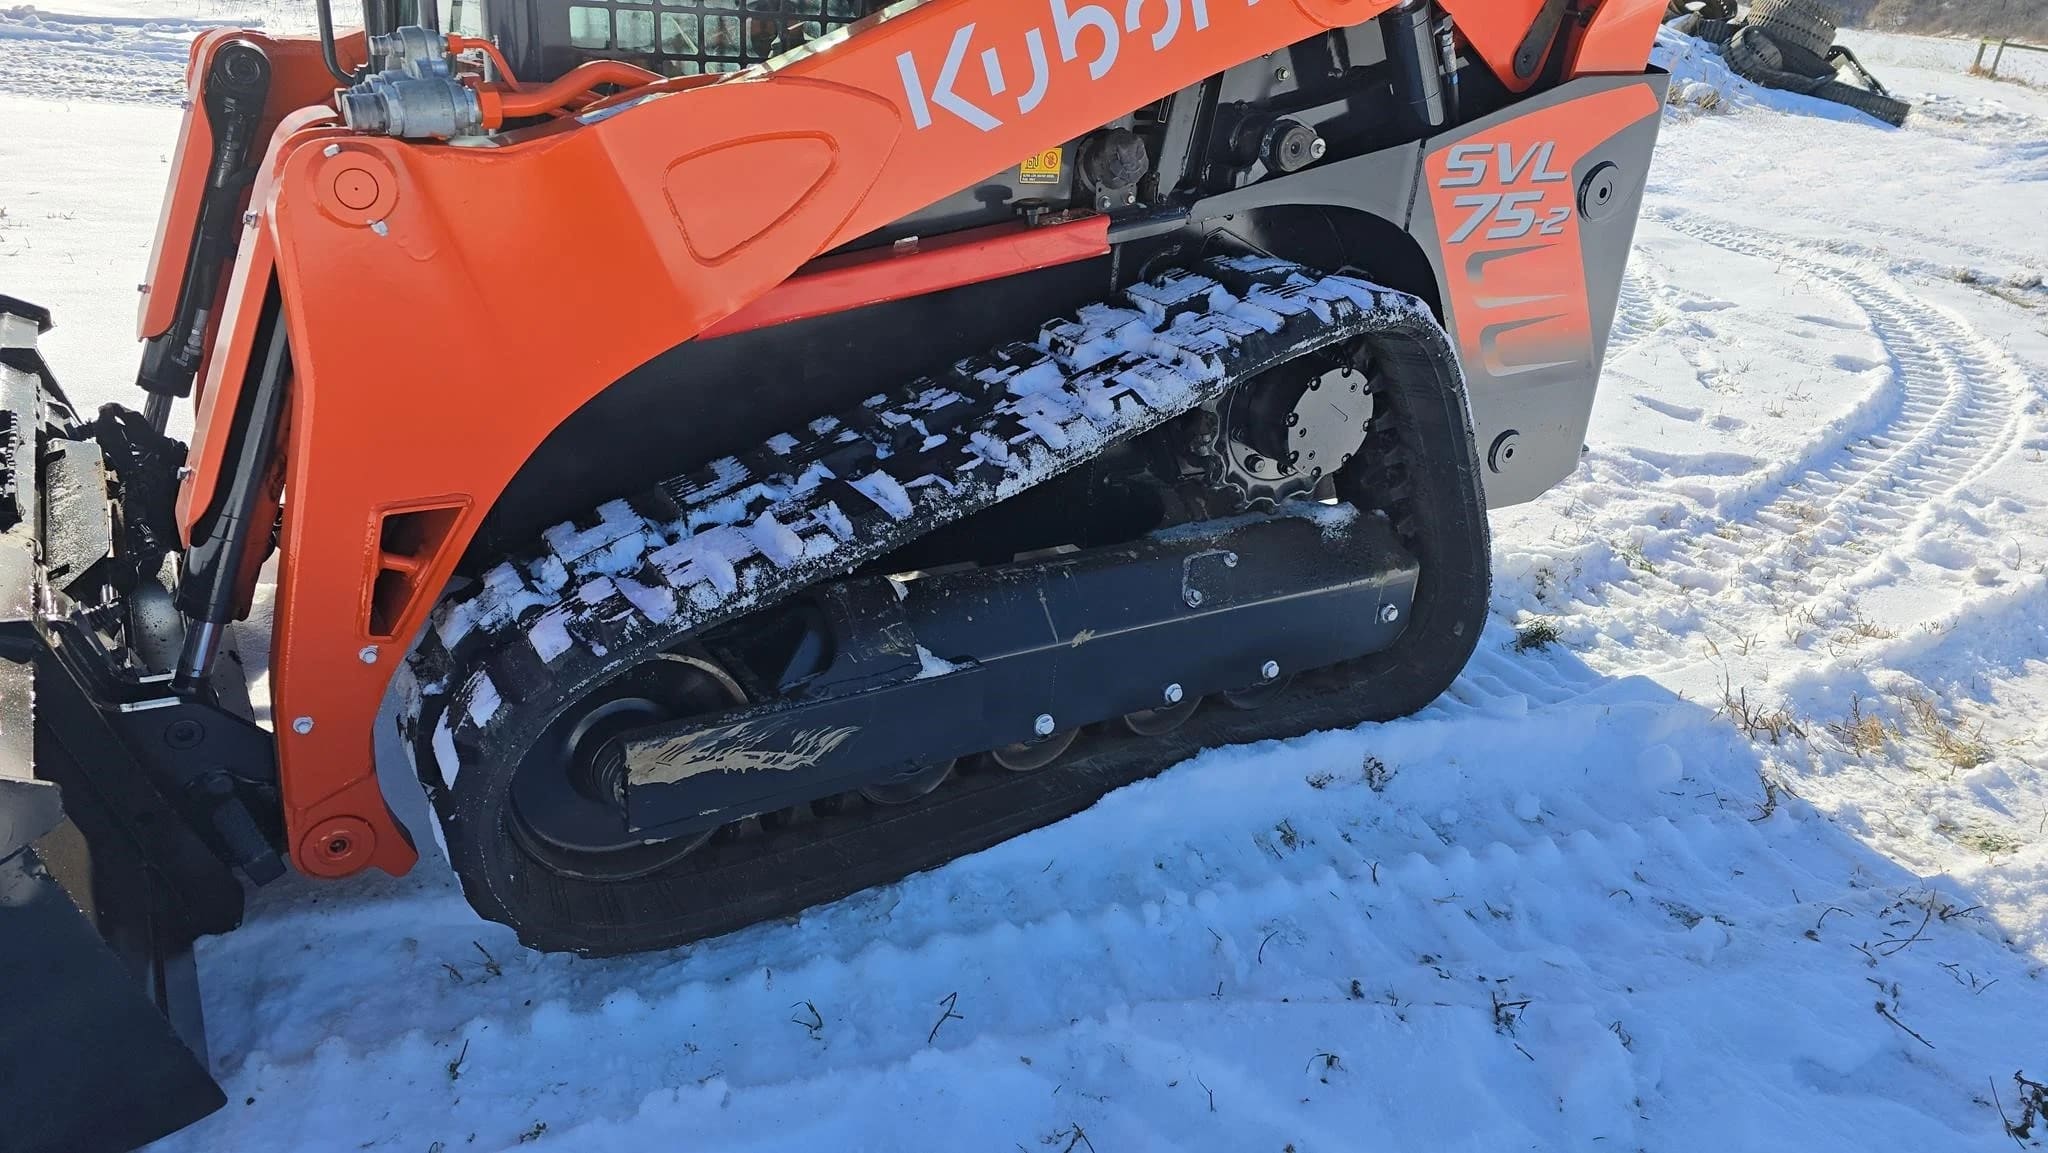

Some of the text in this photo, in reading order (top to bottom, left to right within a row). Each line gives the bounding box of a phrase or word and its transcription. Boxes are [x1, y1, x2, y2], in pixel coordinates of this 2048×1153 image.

[896, 0, 1259, 132] Kubo
[1438, 141, 1568, 188] SVL
[1446, 190, 1571, 244] 75-2
